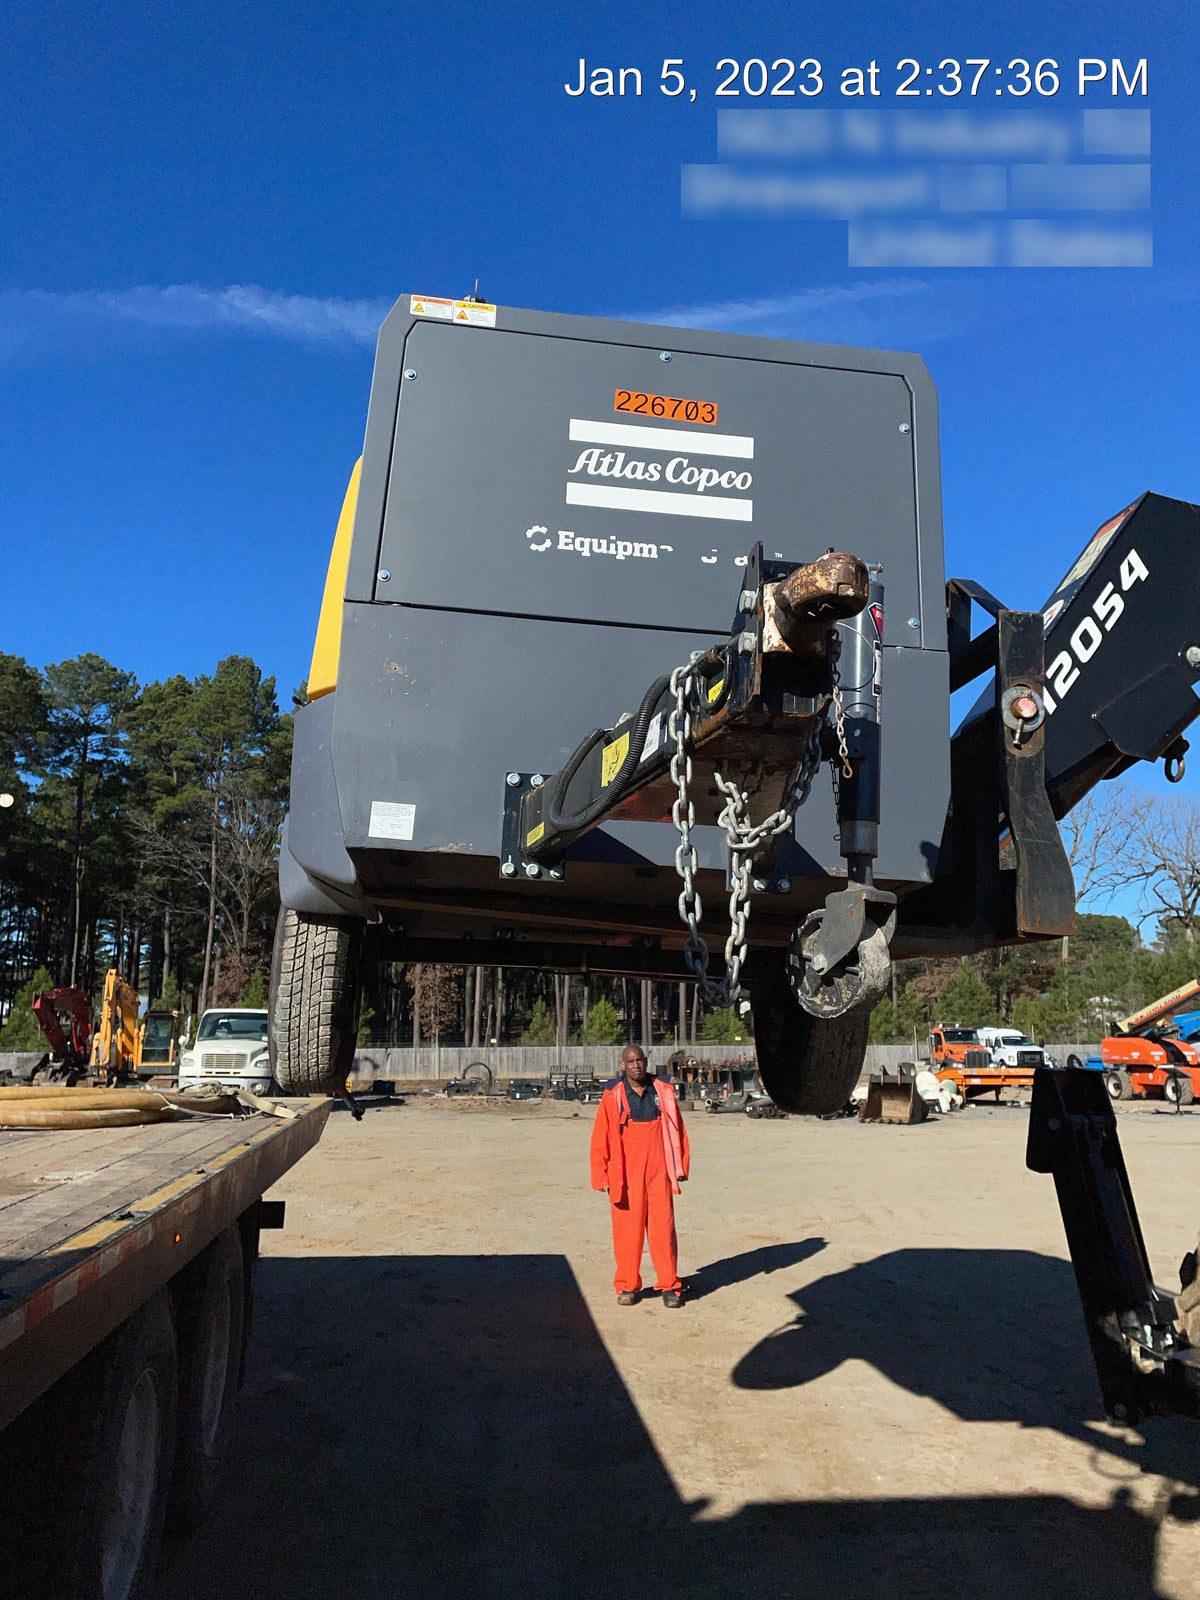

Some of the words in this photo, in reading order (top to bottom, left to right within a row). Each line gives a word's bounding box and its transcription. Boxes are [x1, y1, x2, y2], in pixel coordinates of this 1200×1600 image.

[616, 390, 716, 423] 226703
[568, 448, 662, 482] Atlas
[664, 457, 753, 492] Copco
